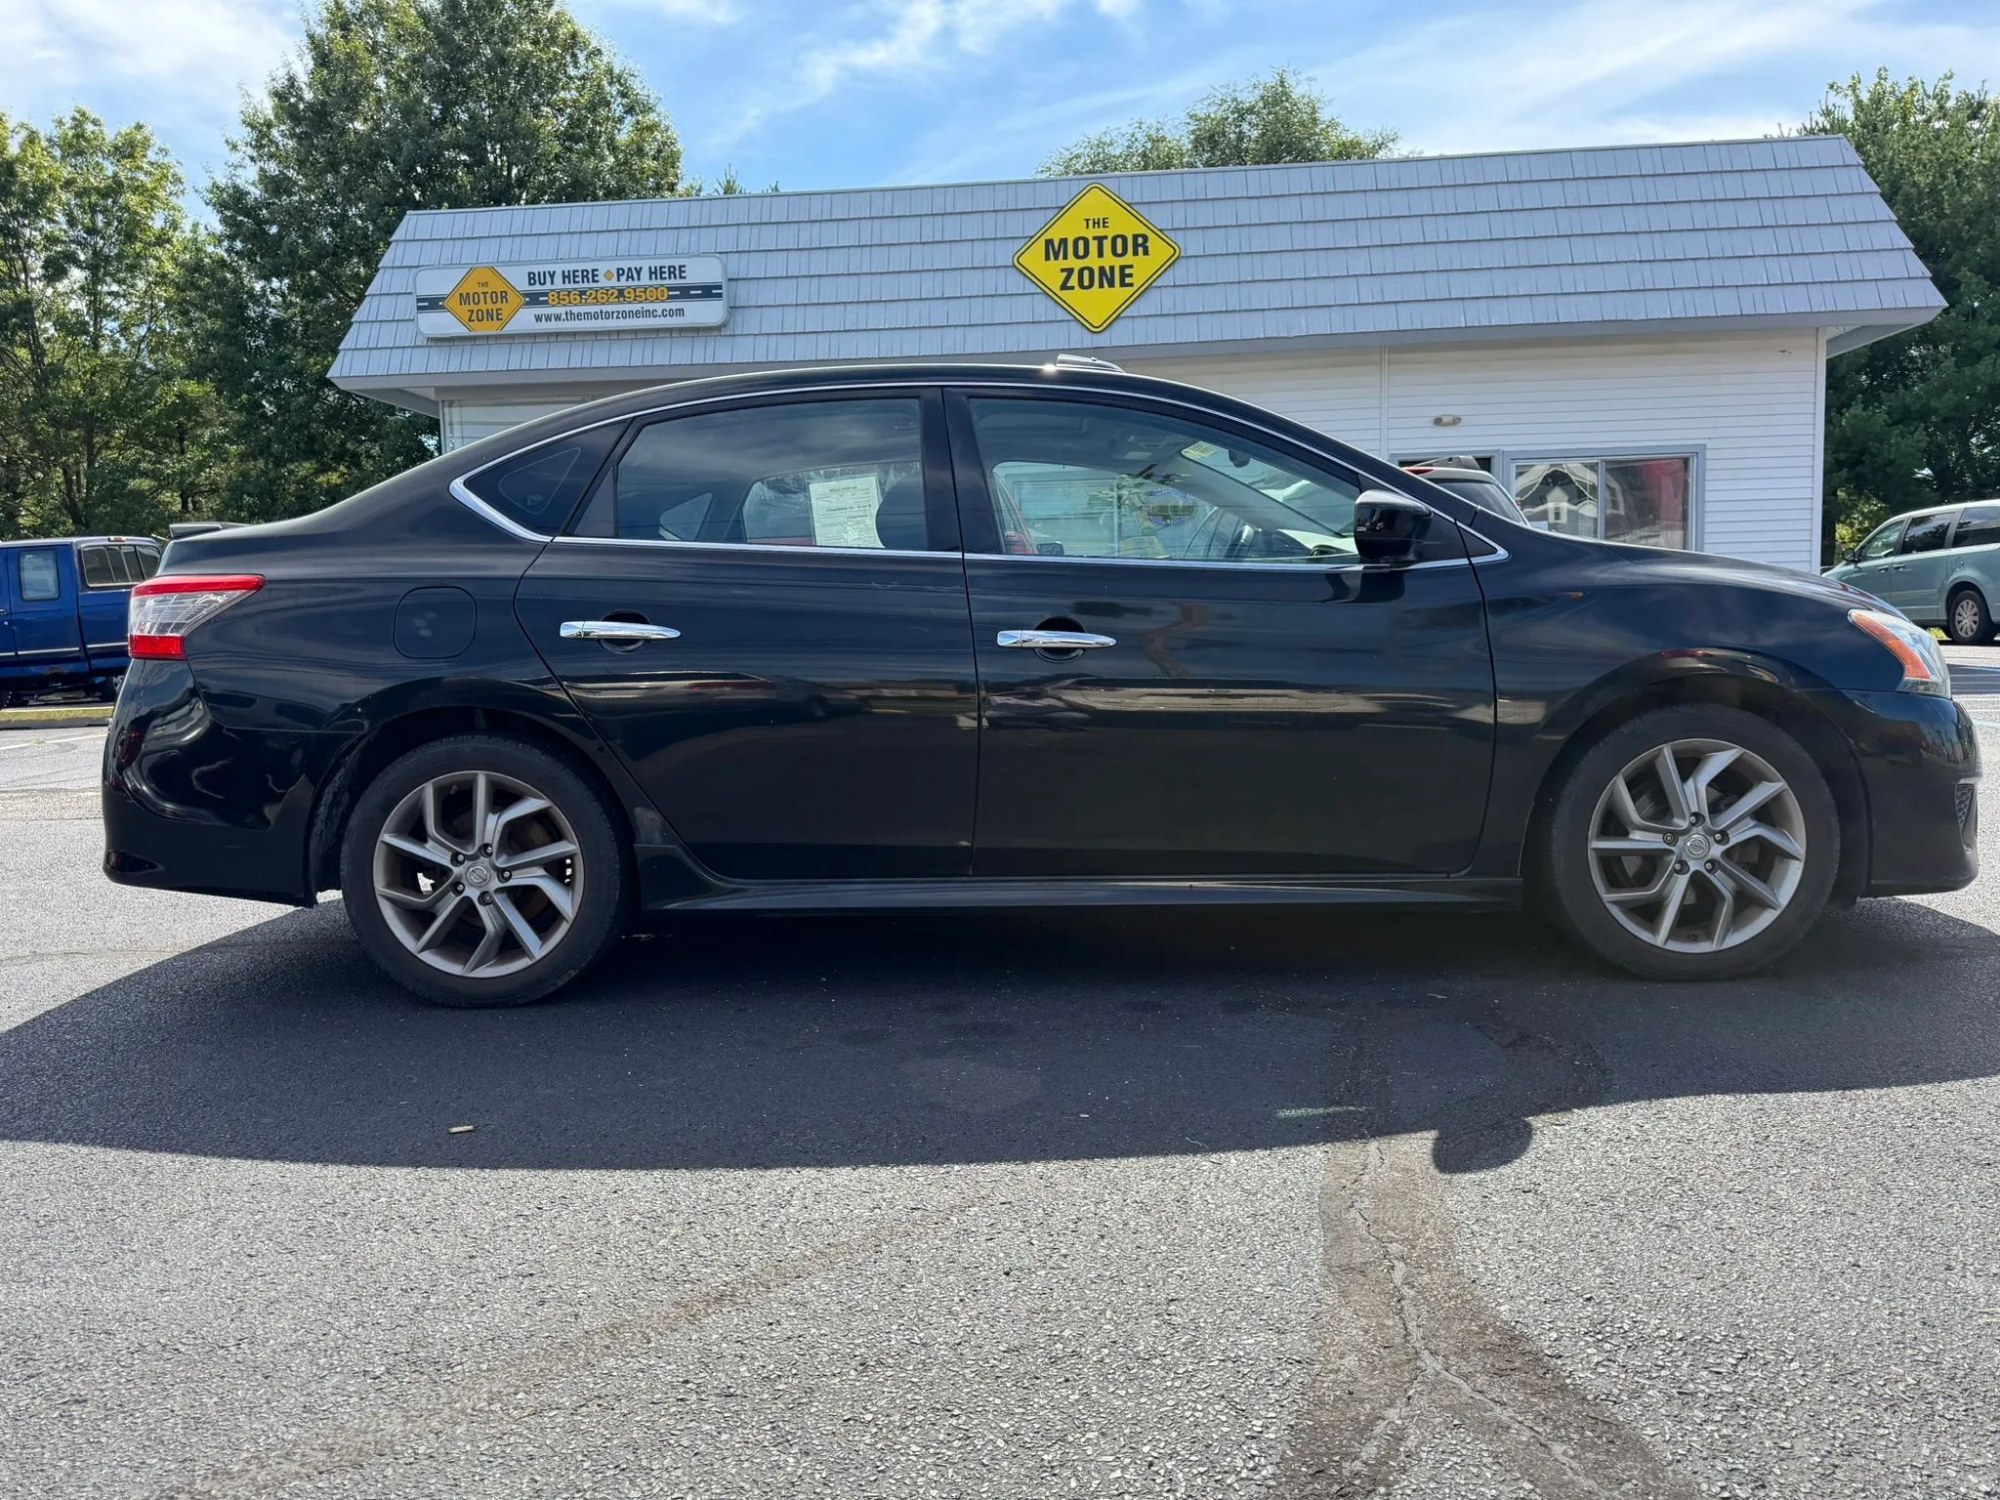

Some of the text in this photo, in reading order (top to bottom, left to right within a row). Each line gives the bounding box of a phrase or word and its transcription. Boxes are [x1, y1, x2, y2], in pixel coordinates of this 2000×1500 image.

[1084, 217, 1109, 229] THE
[1044, 233, 1150, 262] MOTOR
[528, 264, 687, 286] BUY HERE PAY HERE
[1059, 264, 1135, 291] ZONE
[459, 290, 509, 306] MOTOR
[467, 308, 504, 323] ZONE
[534, 307, 685, 323] www.themotorzoneinc.com
